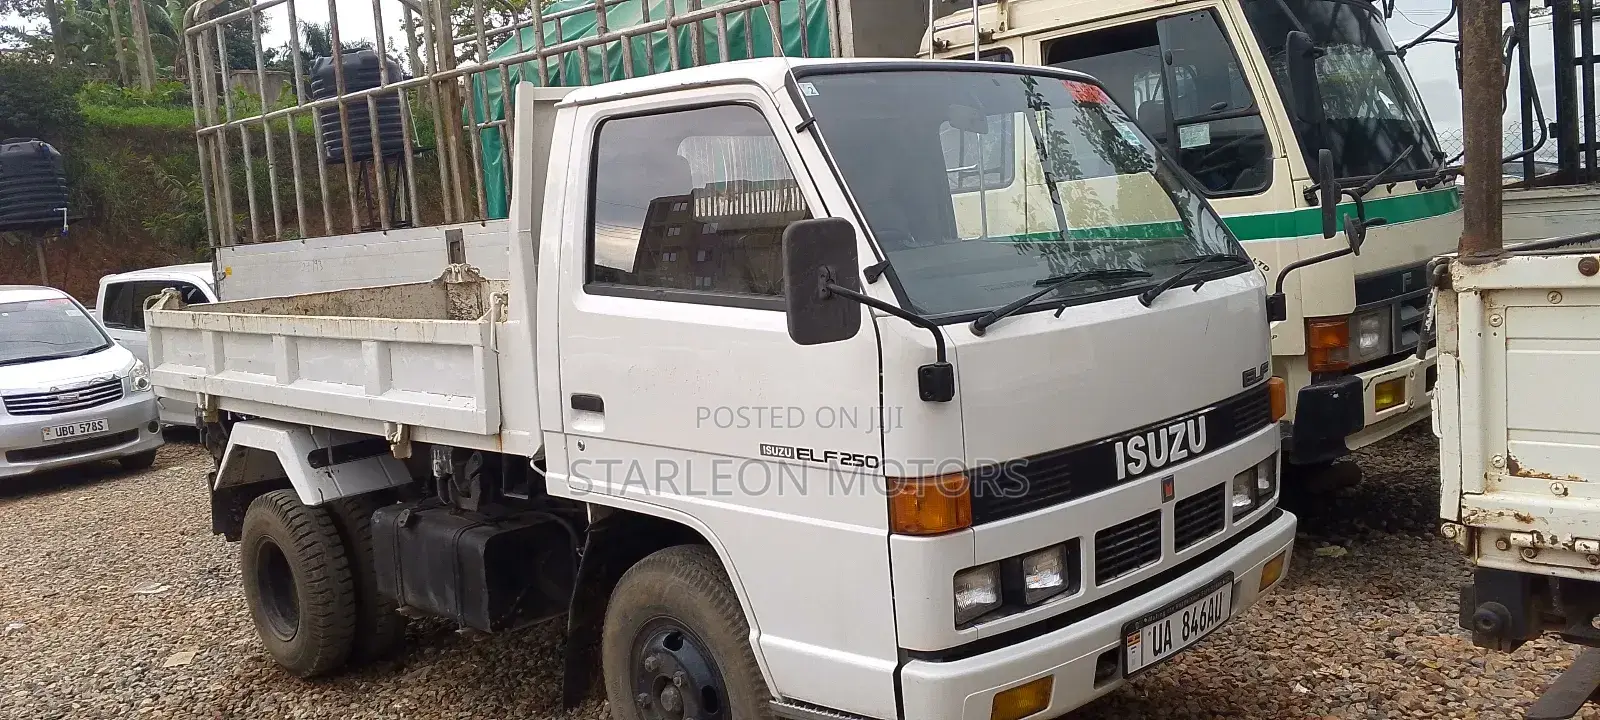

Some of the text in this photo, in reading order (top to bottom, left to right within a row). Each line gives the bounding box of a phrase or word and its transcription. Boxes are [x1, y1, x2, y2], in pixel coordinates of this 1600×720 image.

[1253, 257, 1270, 272] LTD
[1242, 360, 1269, 388] ELF
[55, 420, 104, 437] UBQ 578S
[761, 444, 794, 458] ISUZU
[1115, 415, 1207, 481] ISUZU
[1152, 619, 1172, 657] UA
[1182, 590, 1223, 641] 846AU
